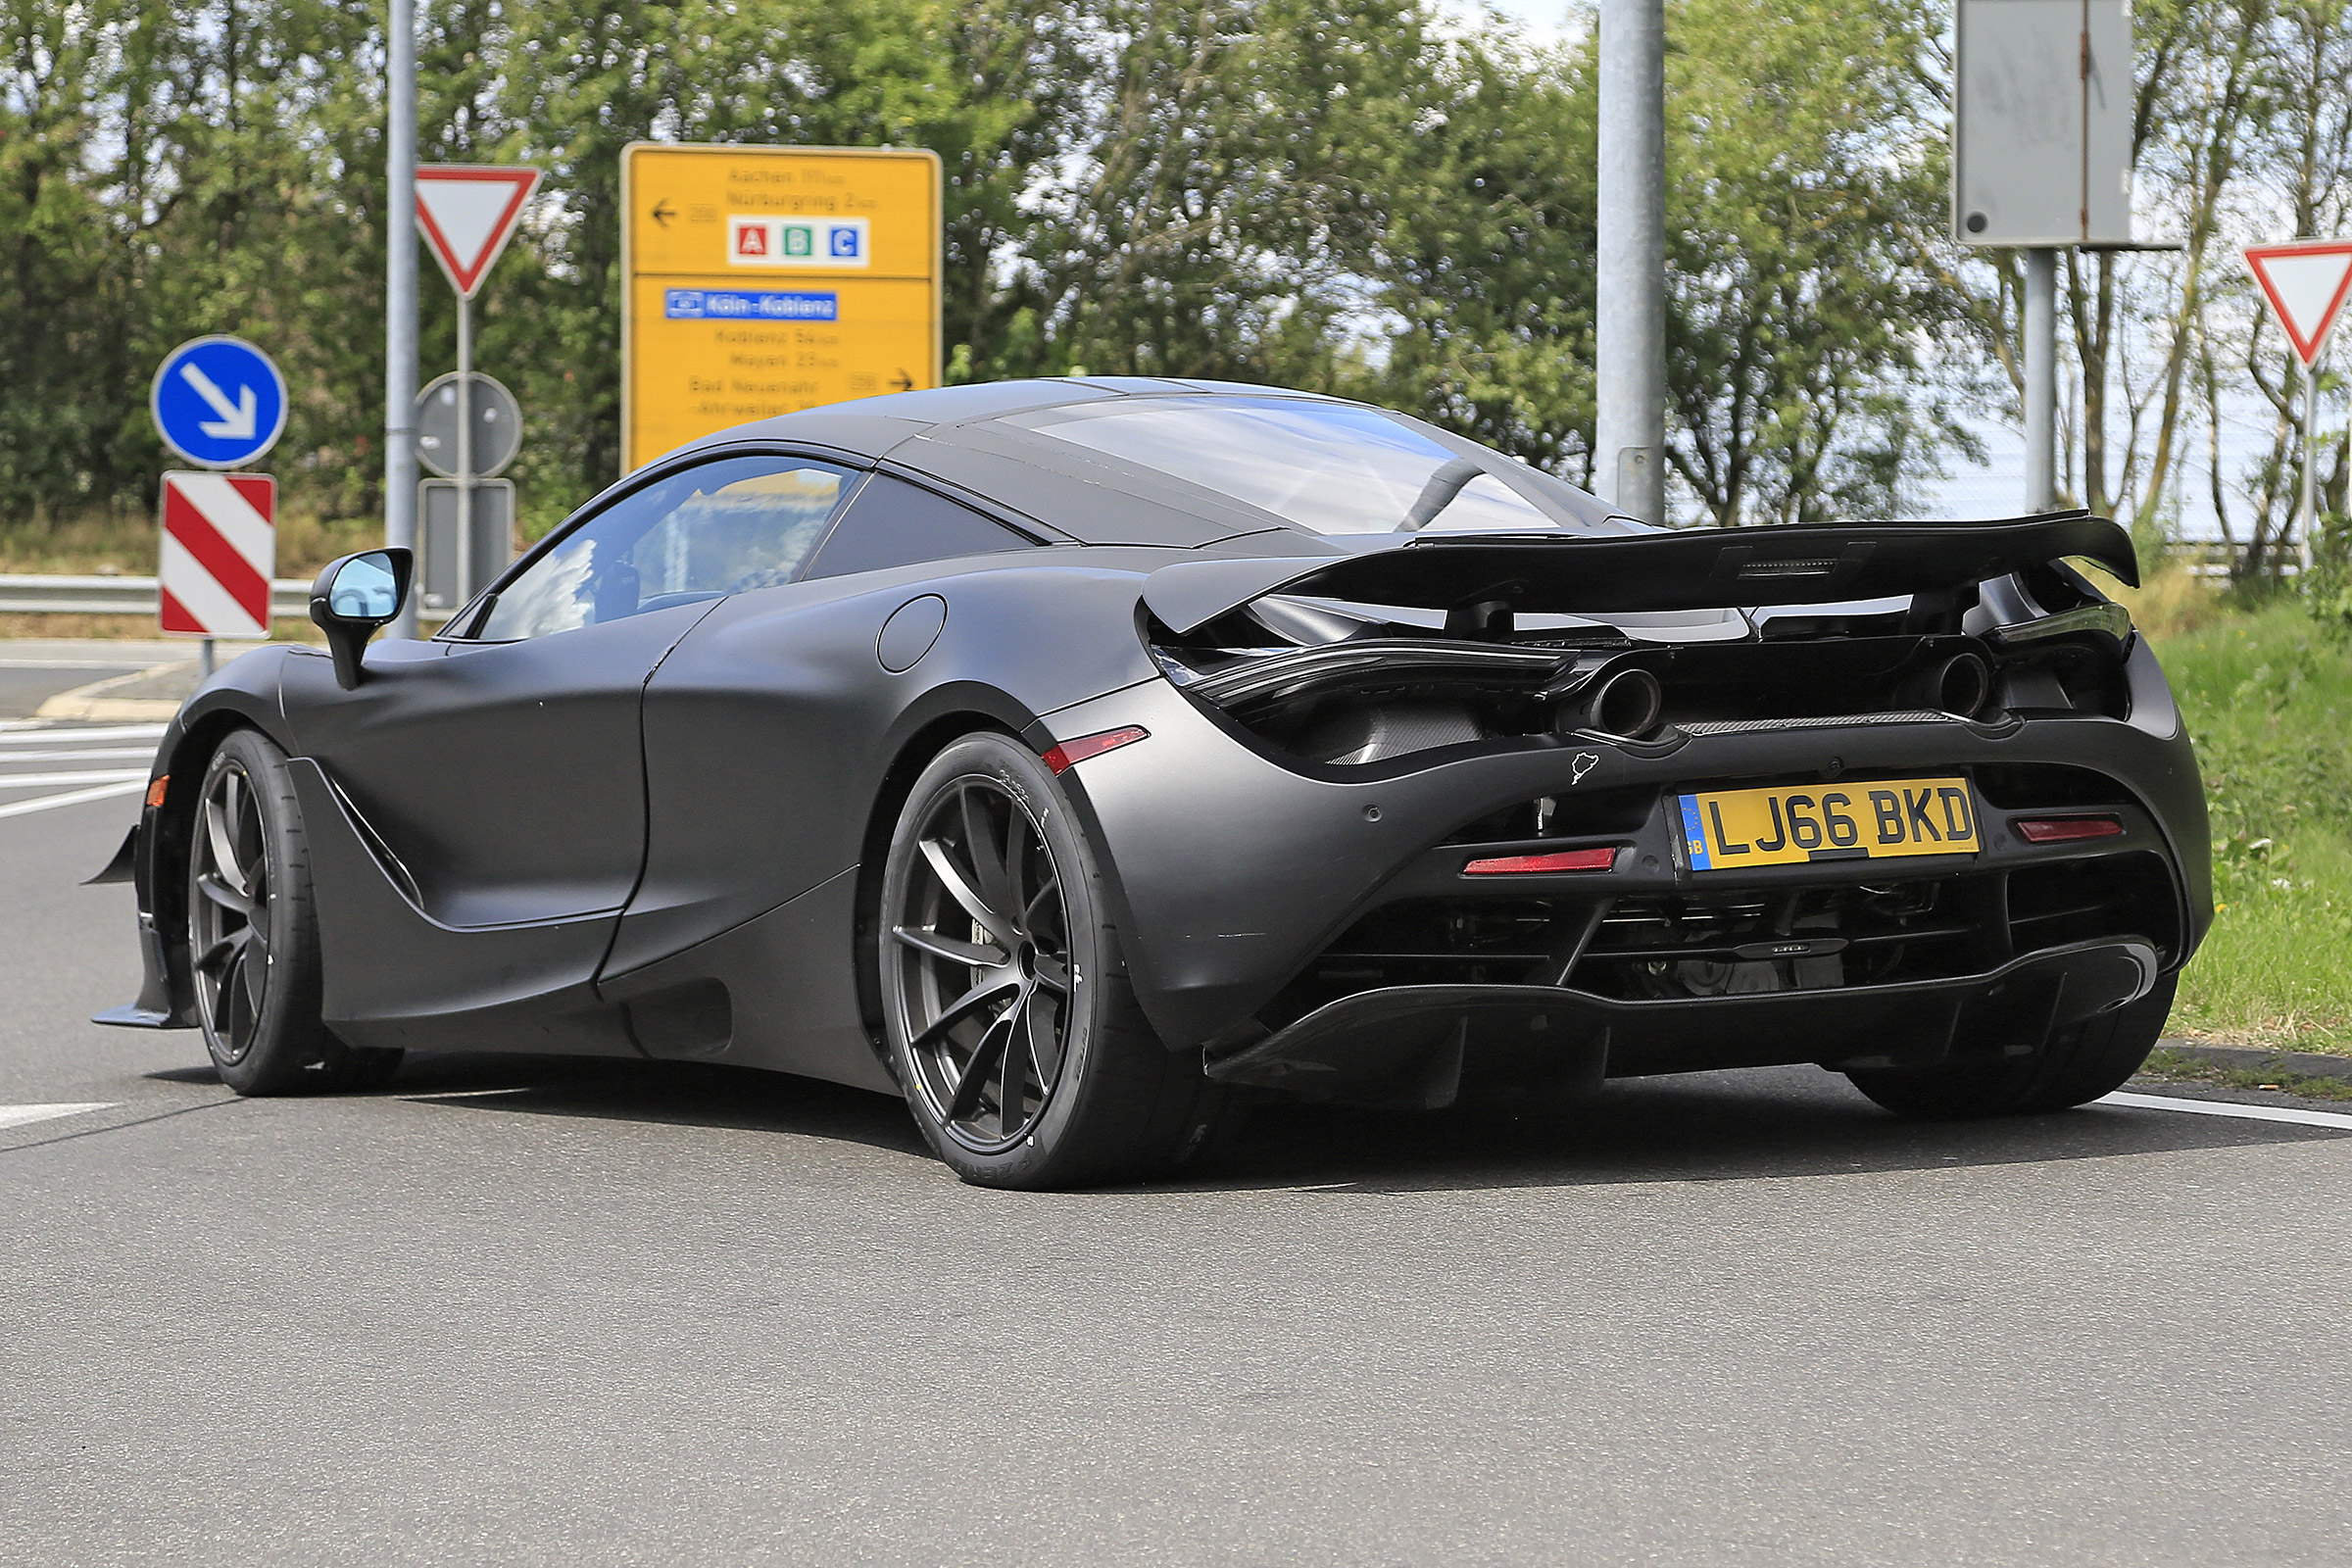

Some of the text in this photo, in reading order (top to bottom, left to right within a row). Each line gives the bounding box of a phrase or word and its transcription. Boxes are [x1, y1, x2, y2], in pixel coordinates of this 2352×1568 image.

[729, 167, 793, 184] Aachen
[742, 227, 858, 257] A B C
[689, 374, 723, 393] Bad
[1709, 787, 1976, 856] LJ66 BKD
